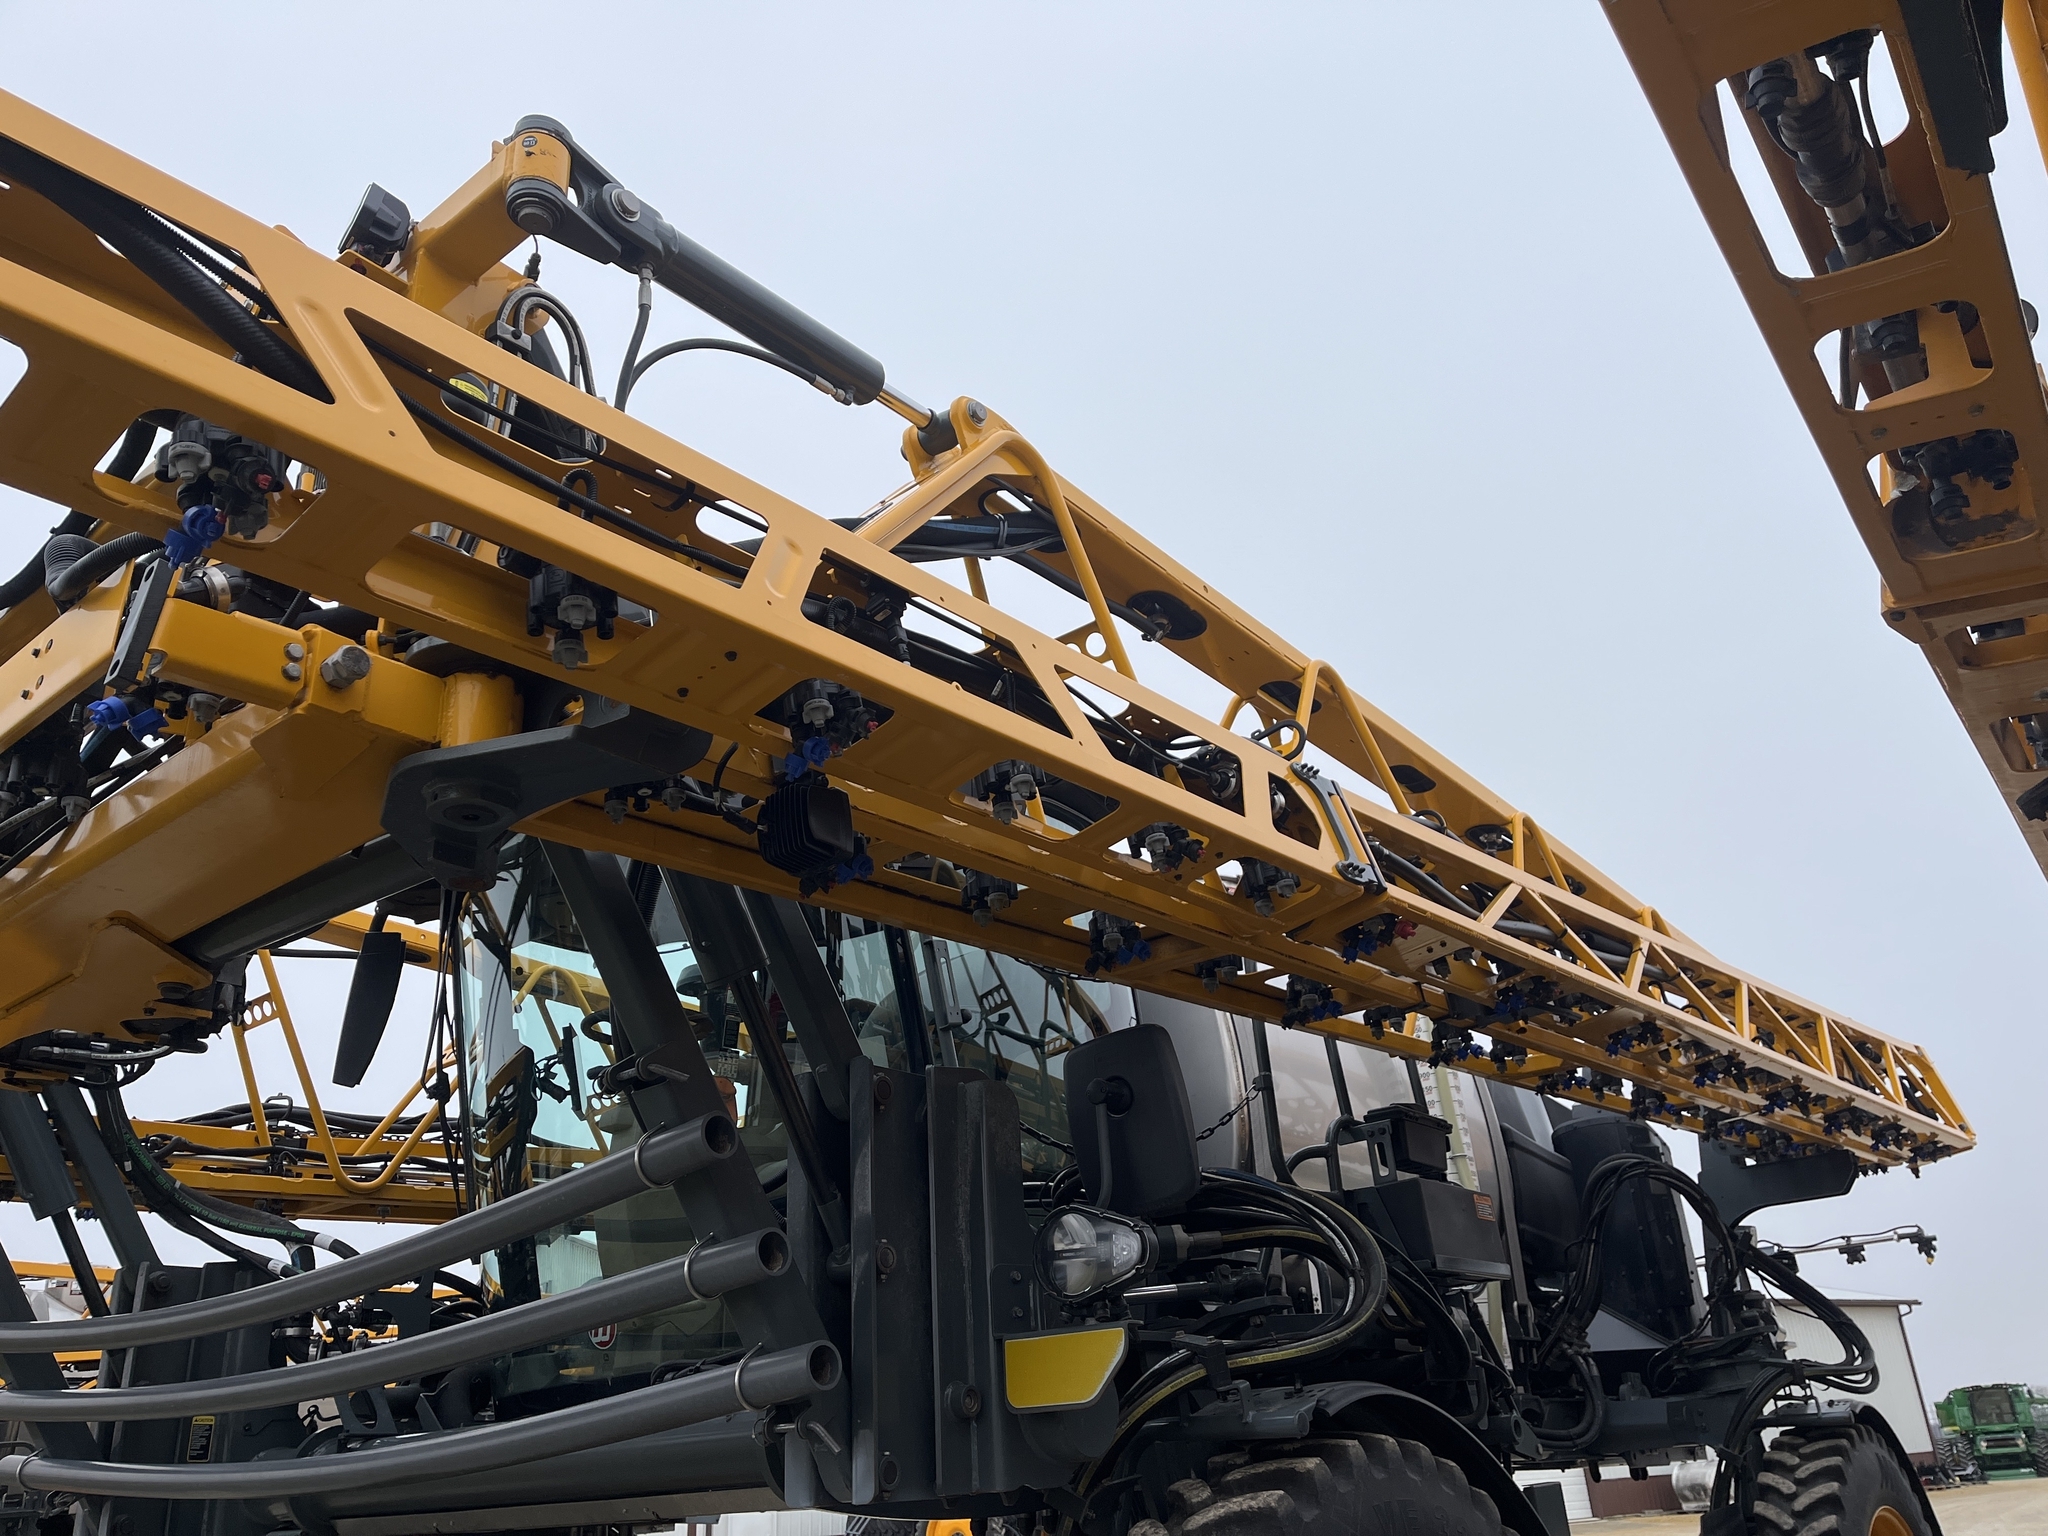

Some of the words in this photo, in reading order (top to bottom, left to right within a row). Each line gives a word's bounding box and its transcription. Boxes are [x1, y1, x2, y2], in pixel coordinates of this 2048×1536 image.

[163, 1183, 202, 1214] EVLUTION
[238, 1223, 263, 1233] GENERAL
[263, 1227, 287, 1236] PURPOSE
